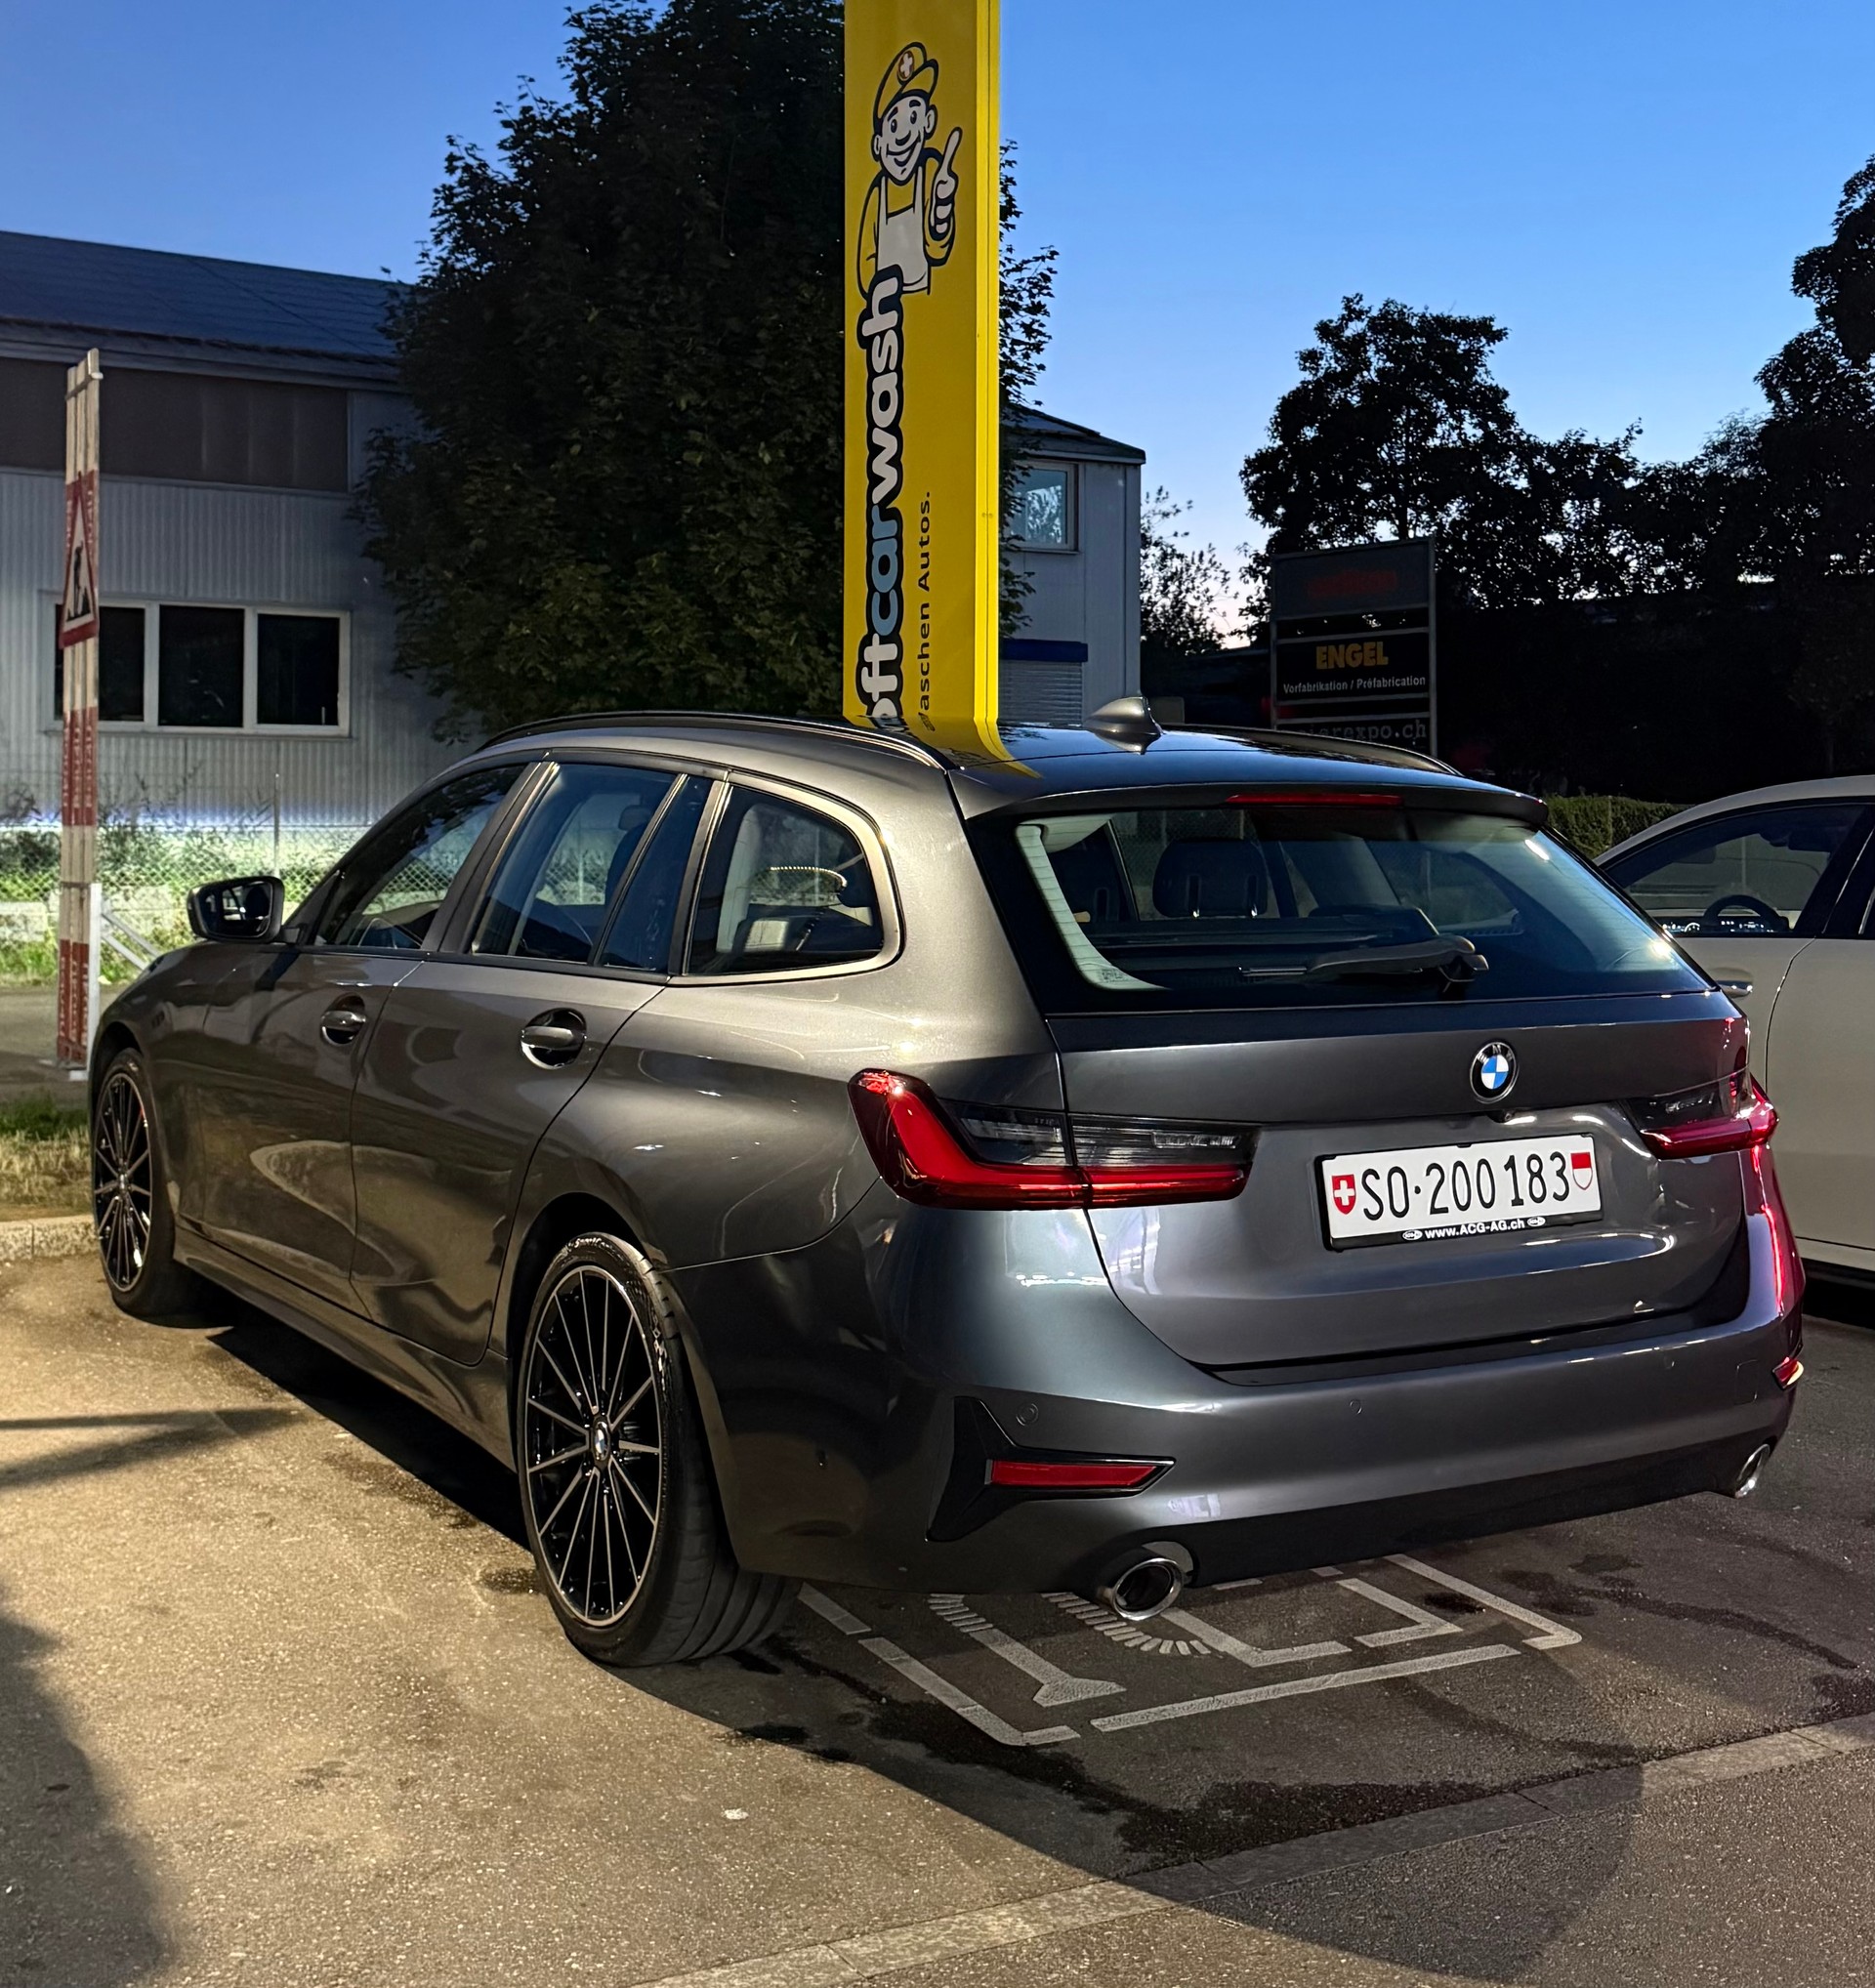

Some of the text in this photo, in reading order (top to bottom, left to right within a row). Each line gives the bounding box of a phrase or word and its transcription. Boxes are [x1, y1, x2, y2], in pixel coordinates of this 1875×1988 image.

[918, 491, 930, 593] Autos.
[1315, 642, 1389, 670] ENGEL
[1282, 680, 1348, 694] Vorfabrikation
[1425, 1218, 1525, 1239] www.ACG-AG.ch
